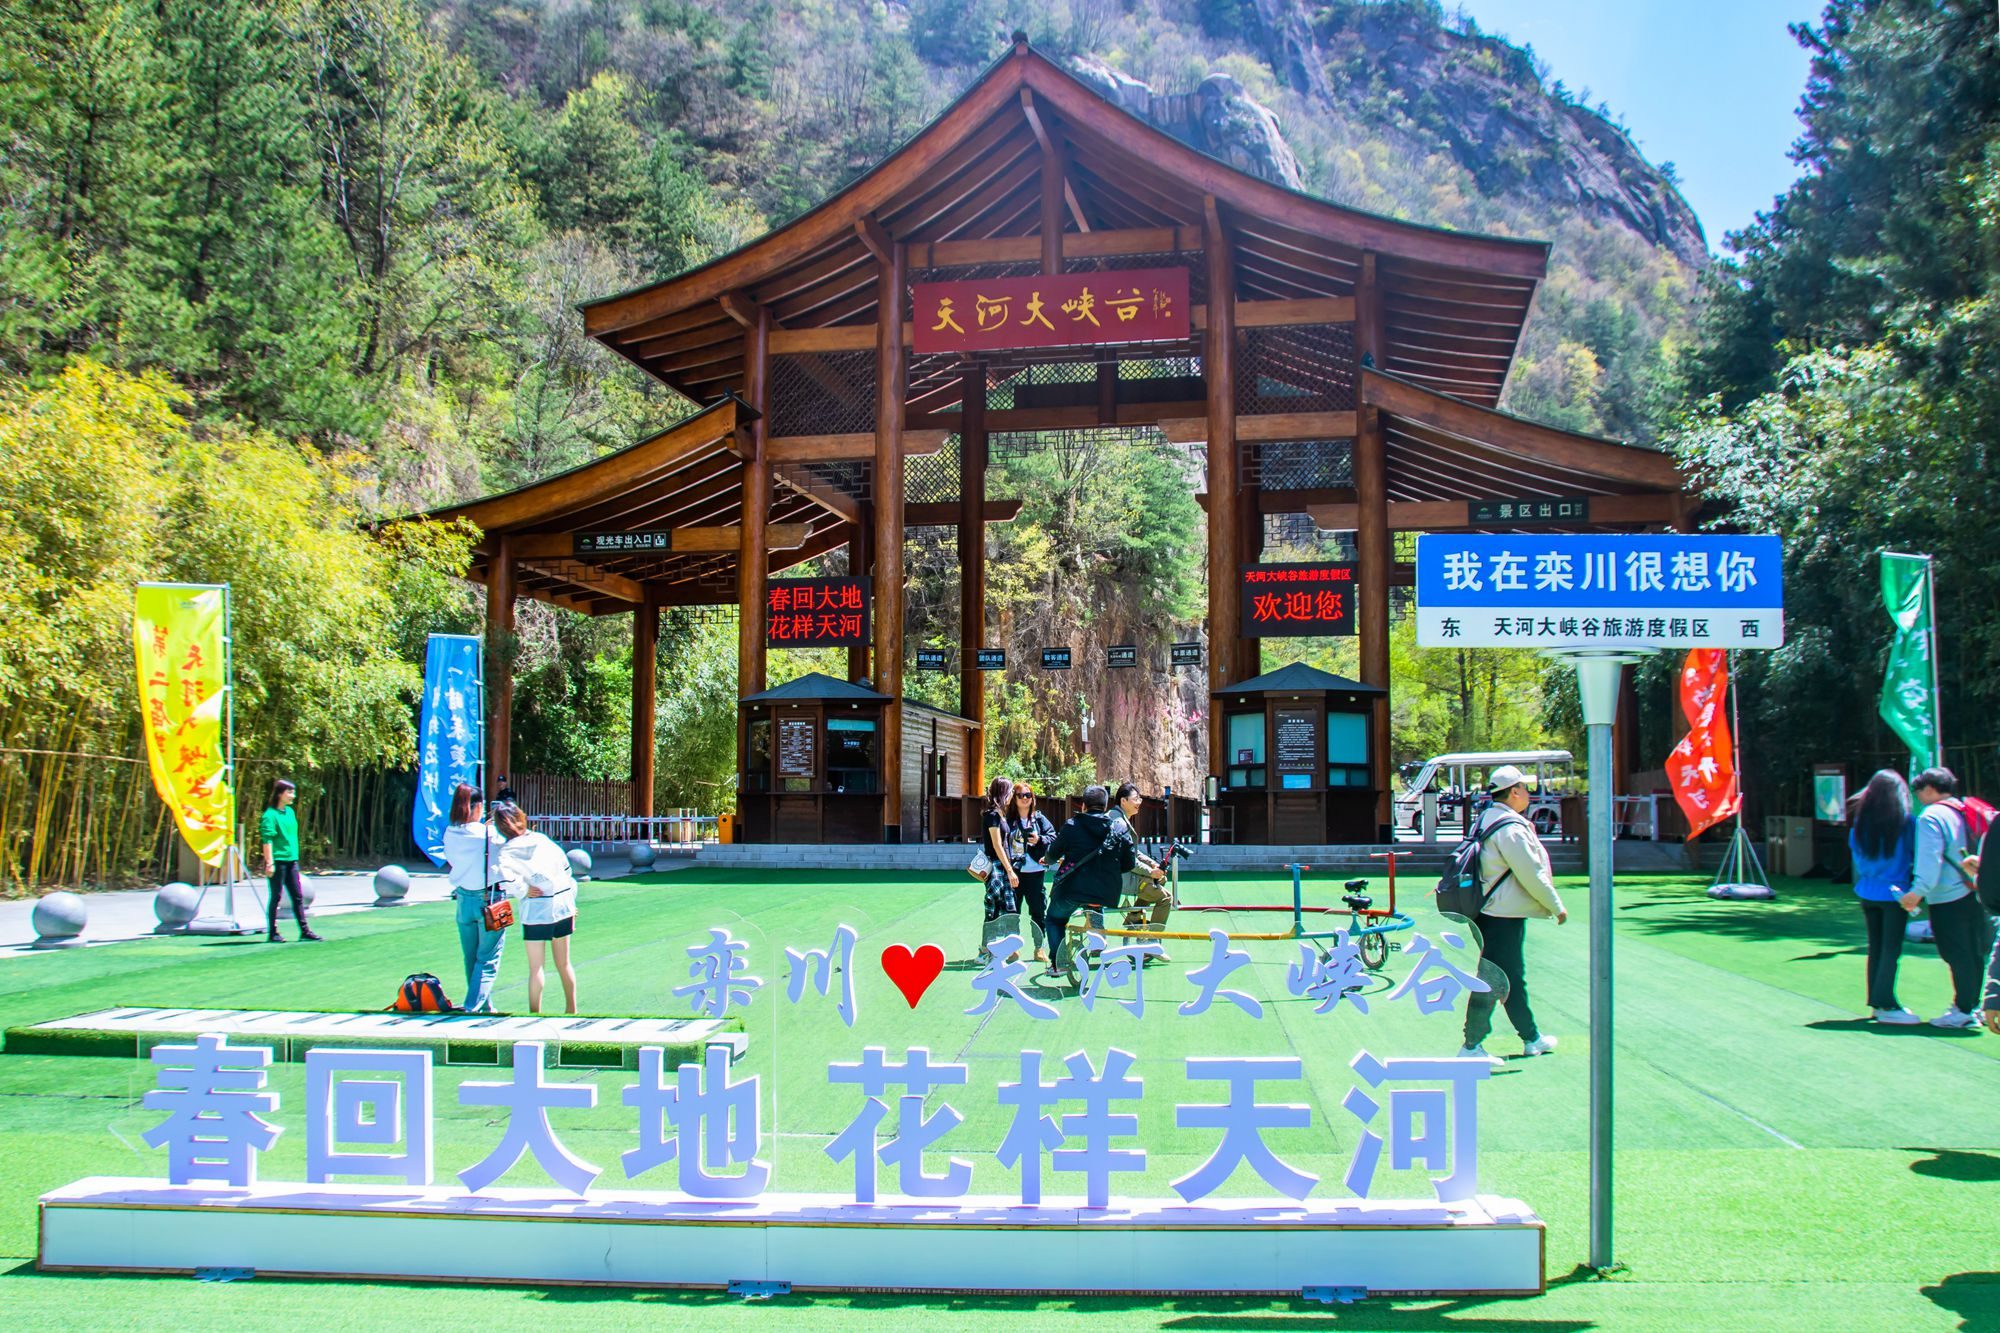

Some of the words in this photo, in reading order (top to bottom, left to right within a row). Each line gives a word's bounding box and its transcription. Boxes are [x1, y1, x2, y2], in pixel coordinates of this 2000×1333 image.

[931, 287, 1145, 335] 天河大峡谷
[1499, 503, 1572, 518] 景区出口
[595, 535, 652, 545] 观光车出入口
[1244, 568, 1351, 583] 天河大峡谷旅游度假区
[1442, 550, 1758, 593] 我在栾川很想你
[768, 585, 862, 611] 春回大地
[1252, 590, 1344, 622] 欢迎您
[768, 614, 862, 640] 花样天河
[1441, 617, 1461, 638] 东
[1494, 617, 1711, 638] 天河大峡谷旅游度假区
[1740, 619, 1760, 638] 西
[673, 922, 860, 1028] 栾川
[963, 926, 1492, 1022] 天河大峡谷
[141, 1032, 772, 1200] 春回大地
[823, 1046, 1493, 1208] 花样天河
